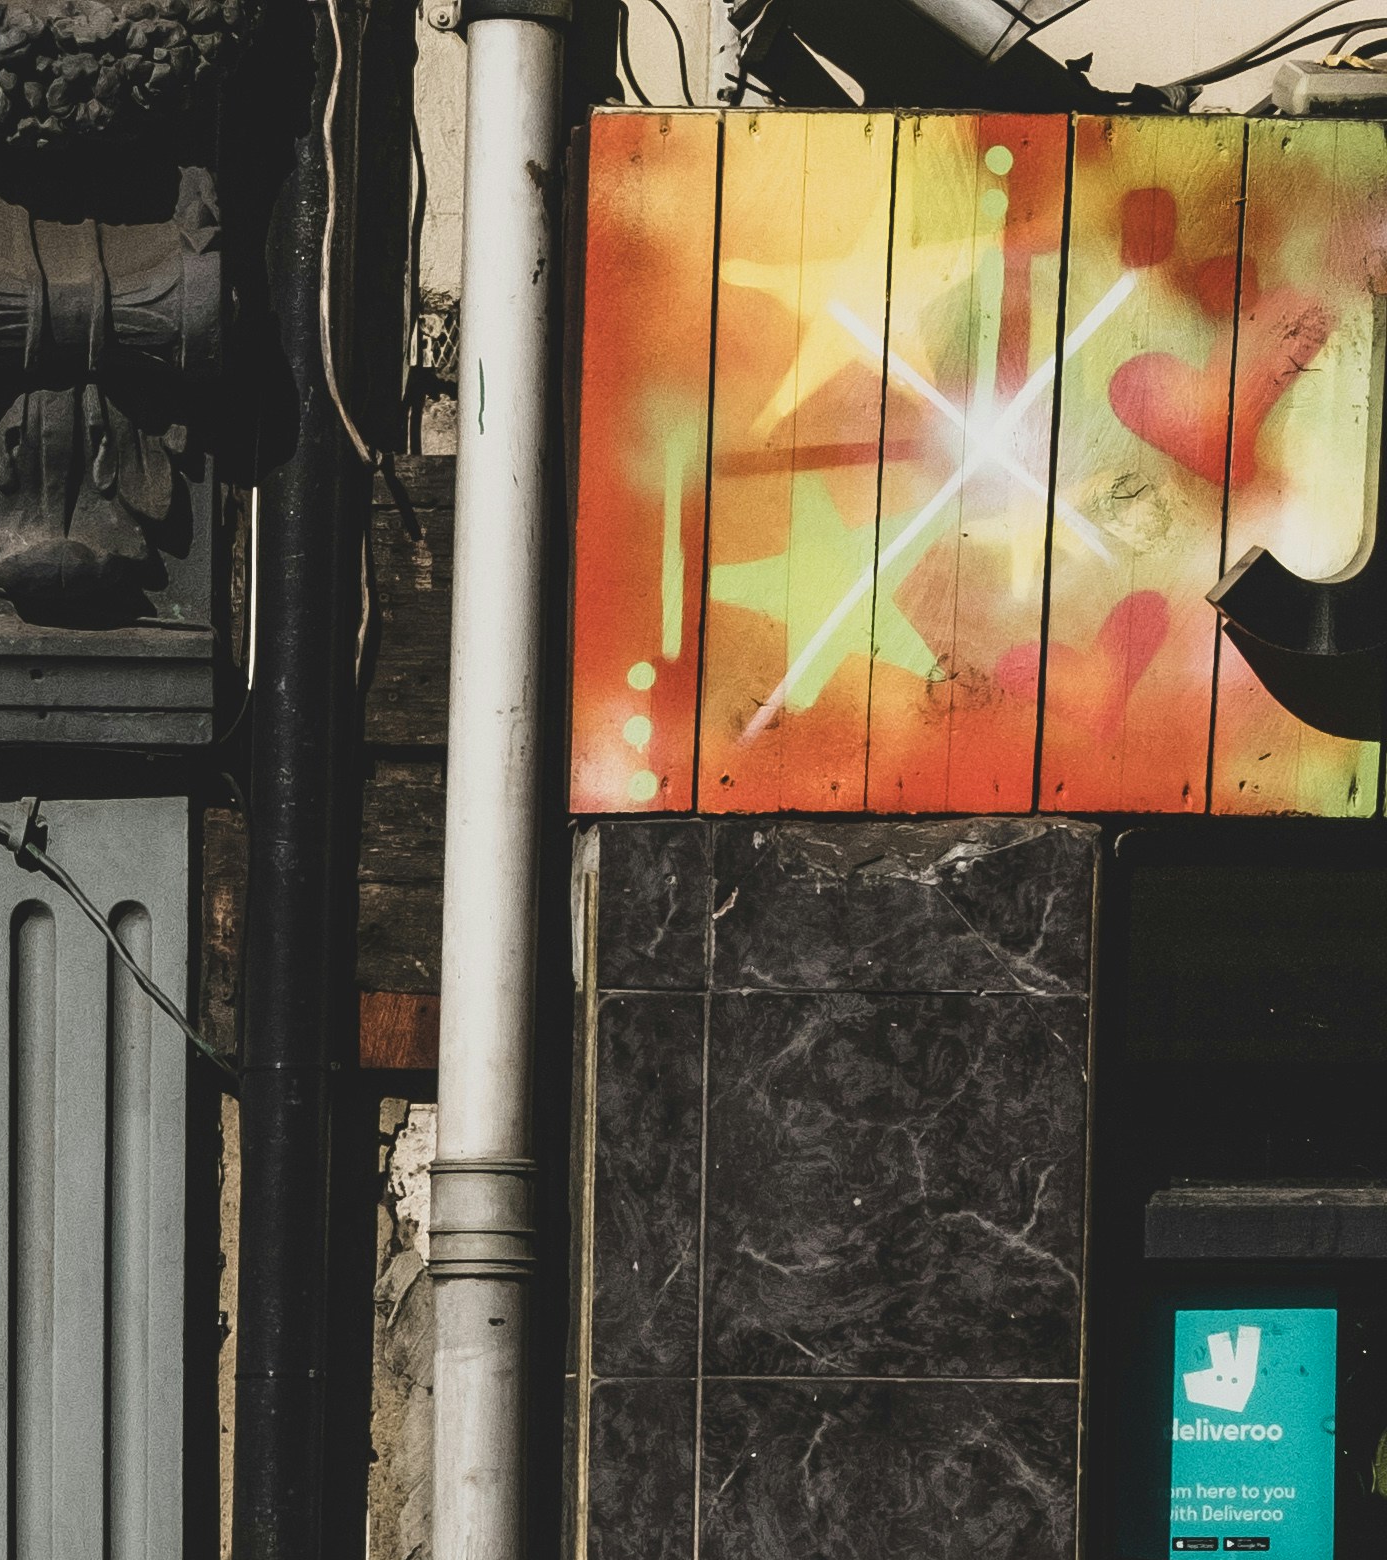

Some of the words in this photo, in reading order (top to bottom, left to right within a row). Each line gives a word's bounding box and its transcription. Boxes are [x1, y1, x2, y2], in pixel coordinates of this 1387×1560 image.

[1196, 1483, 1237, 1499] here
[1241, 1484, 1260, 1499] to
[1263, 1486, 1296, 1504] you
[1202, 1504, 1284, 1521] Deliveroo
